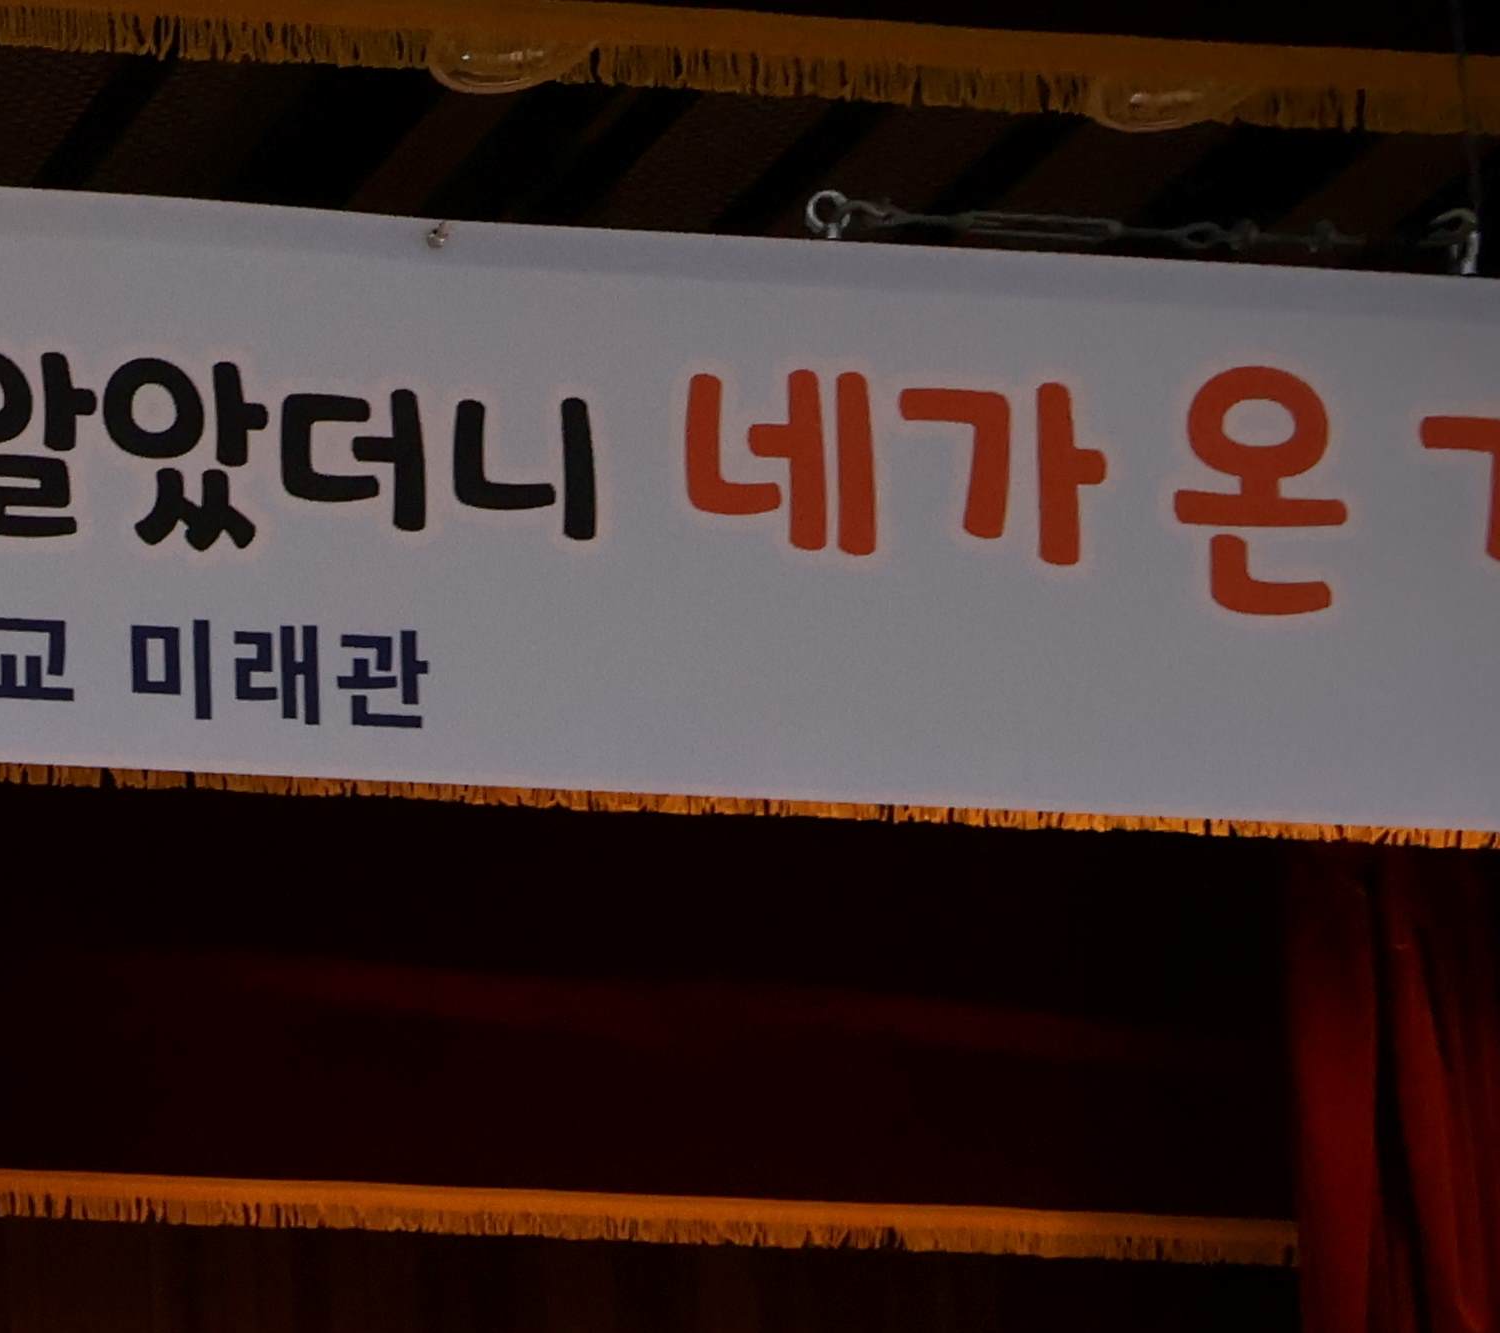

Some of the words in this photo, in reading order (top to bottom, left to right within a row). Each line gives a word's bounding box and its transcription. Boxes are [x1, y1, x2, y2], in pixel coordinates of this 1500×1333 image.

[685, 368, 1107, 566] 네가
[1173, 366, 1348, 616] 온
[131, 619, 429, 729] 미래관
